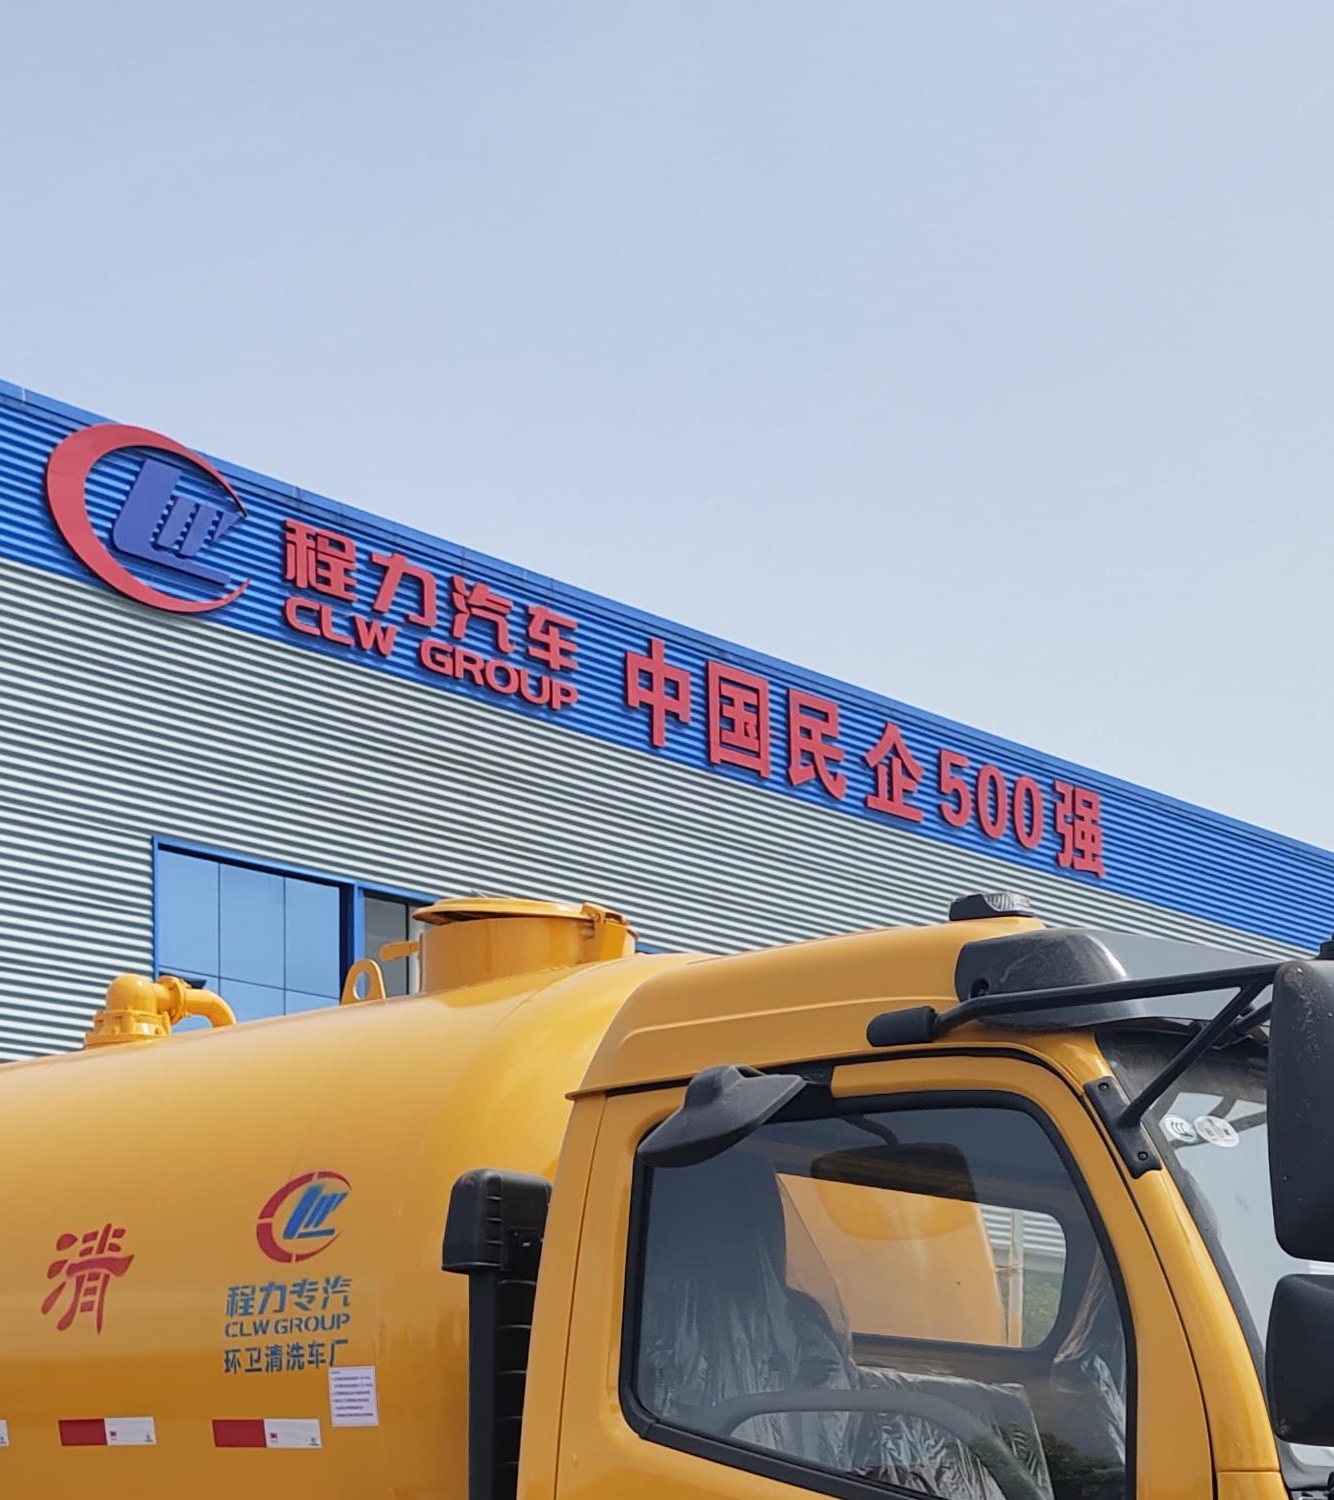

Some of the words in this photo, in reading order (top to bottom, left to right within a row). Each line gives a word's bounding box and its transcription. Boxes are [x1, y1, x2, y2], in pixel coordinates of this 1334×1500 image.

[282, 518, 579, 671] 程力汽车
[283, 596, 397, 658] CLW
[418, 639, 580, 711] GROUP
[624, 637, 1105, 879] 中国民企500强
[224, 1319, 271, 1338] CLW
[274, 1312, 351, 1335] GROUP
[225, 1275, 353, 1317] 程力专汽
[223, 1338, 350, 1376] 环卫清洗车厂
